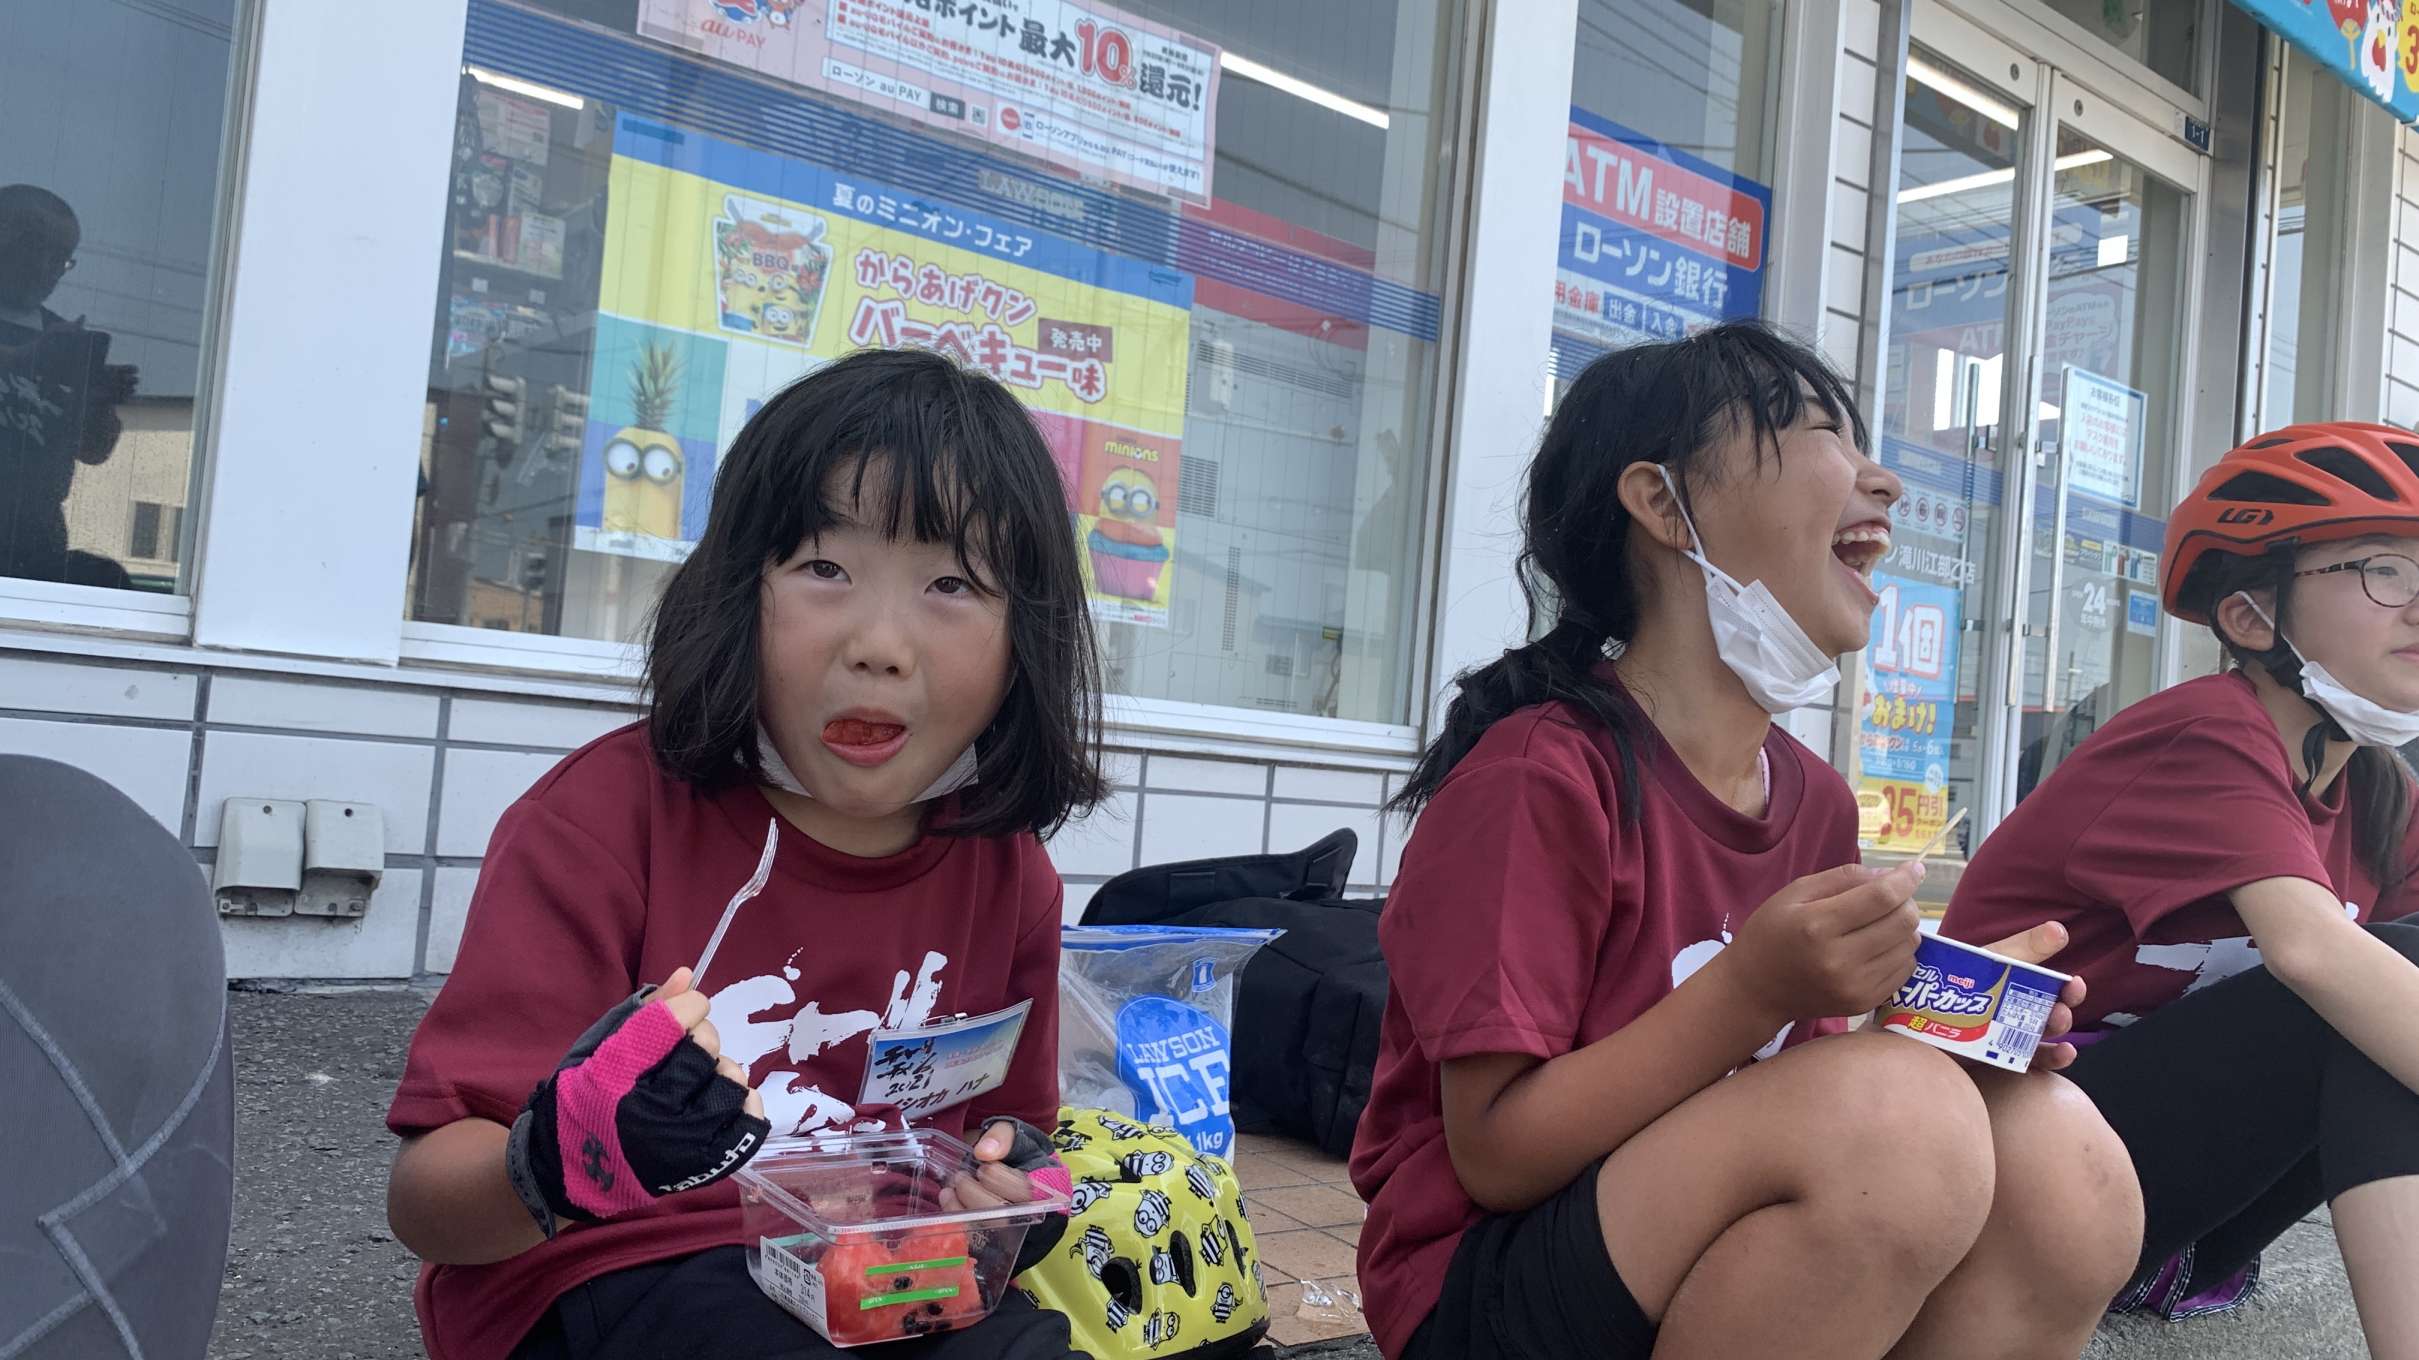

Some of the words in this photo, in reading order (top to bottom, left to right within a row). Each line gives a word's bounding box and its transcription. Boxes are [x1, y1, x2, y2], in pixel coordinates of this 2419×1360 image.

[737, 33, 766, 49] PAY
[832, 65, 876, 88] ローソン
[880, 82, 895, 94] au
[899, 86, 922, 101] PAY
[832, 182, 1033, 258] 夏のミニオン・フェア
[753, 252, 789, 271] BBQ
[1573, 220, 1729, 309] ローソン銀行
[856, 249, 1036, 325] からあげクン
[1608, 298, 1638, 323] 出金
[850, 297, 1106, 402] バーベキュー味
[1051, 327, 1102, 352] 発売中
[1105, 441, 1159, 462] minions
[2083, 582, 2106, 615] 24
[1873, 584, 1944, 678] 1個
[1871, 694, 1937, 735] おまけ!
[1947, 974, 1975, 990] meiji
[1126, 1025, 1221, 1064] LAWSON
[1137, 1049, 1230, 1126] ICE
